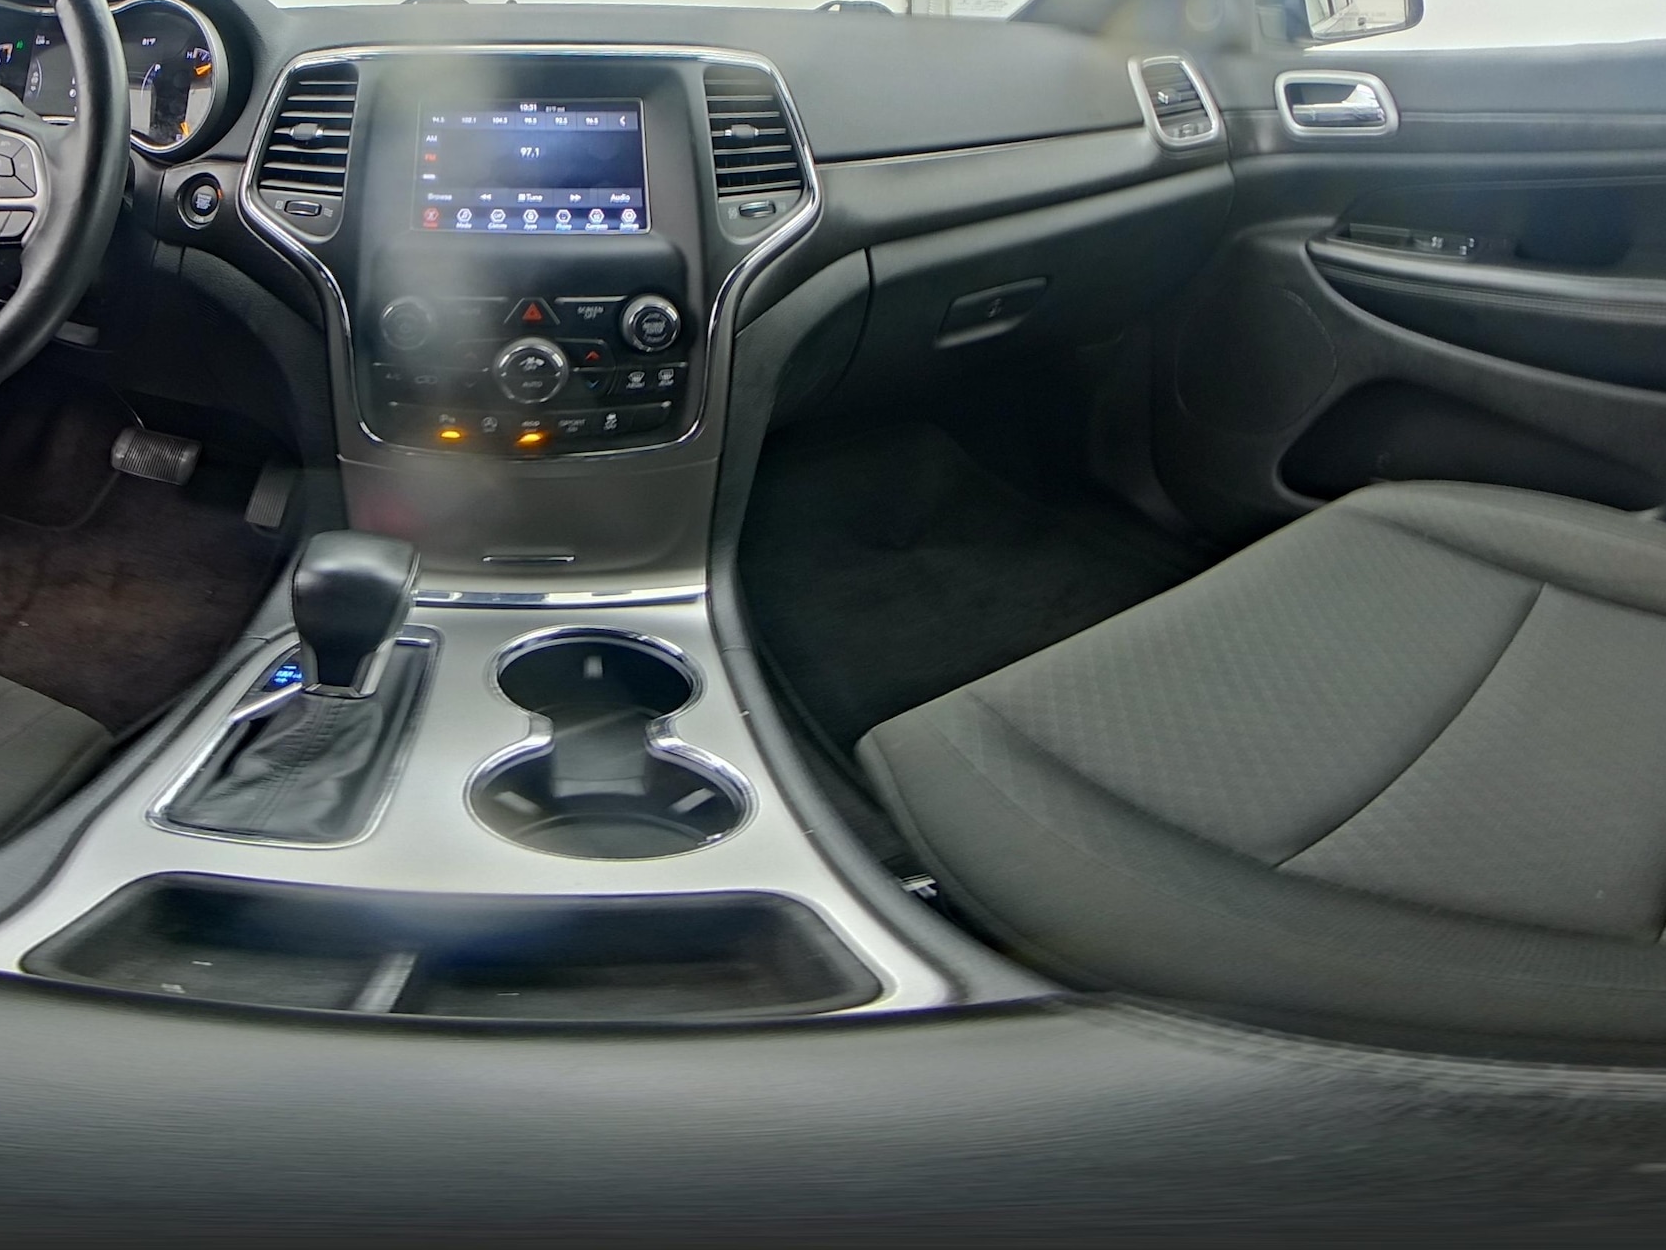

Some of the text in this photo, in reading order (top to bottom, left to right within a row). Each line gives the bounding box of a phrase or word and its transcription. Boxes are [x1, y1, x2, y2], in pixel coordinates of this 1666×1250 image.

[154, 63, 161, 72] P
[519, 104, 537, 112] 10:31
[520, 147, 539, 157] 97.1
[526, 193, 543, 201] Tune
[610, 193, 631, 202] Audio
